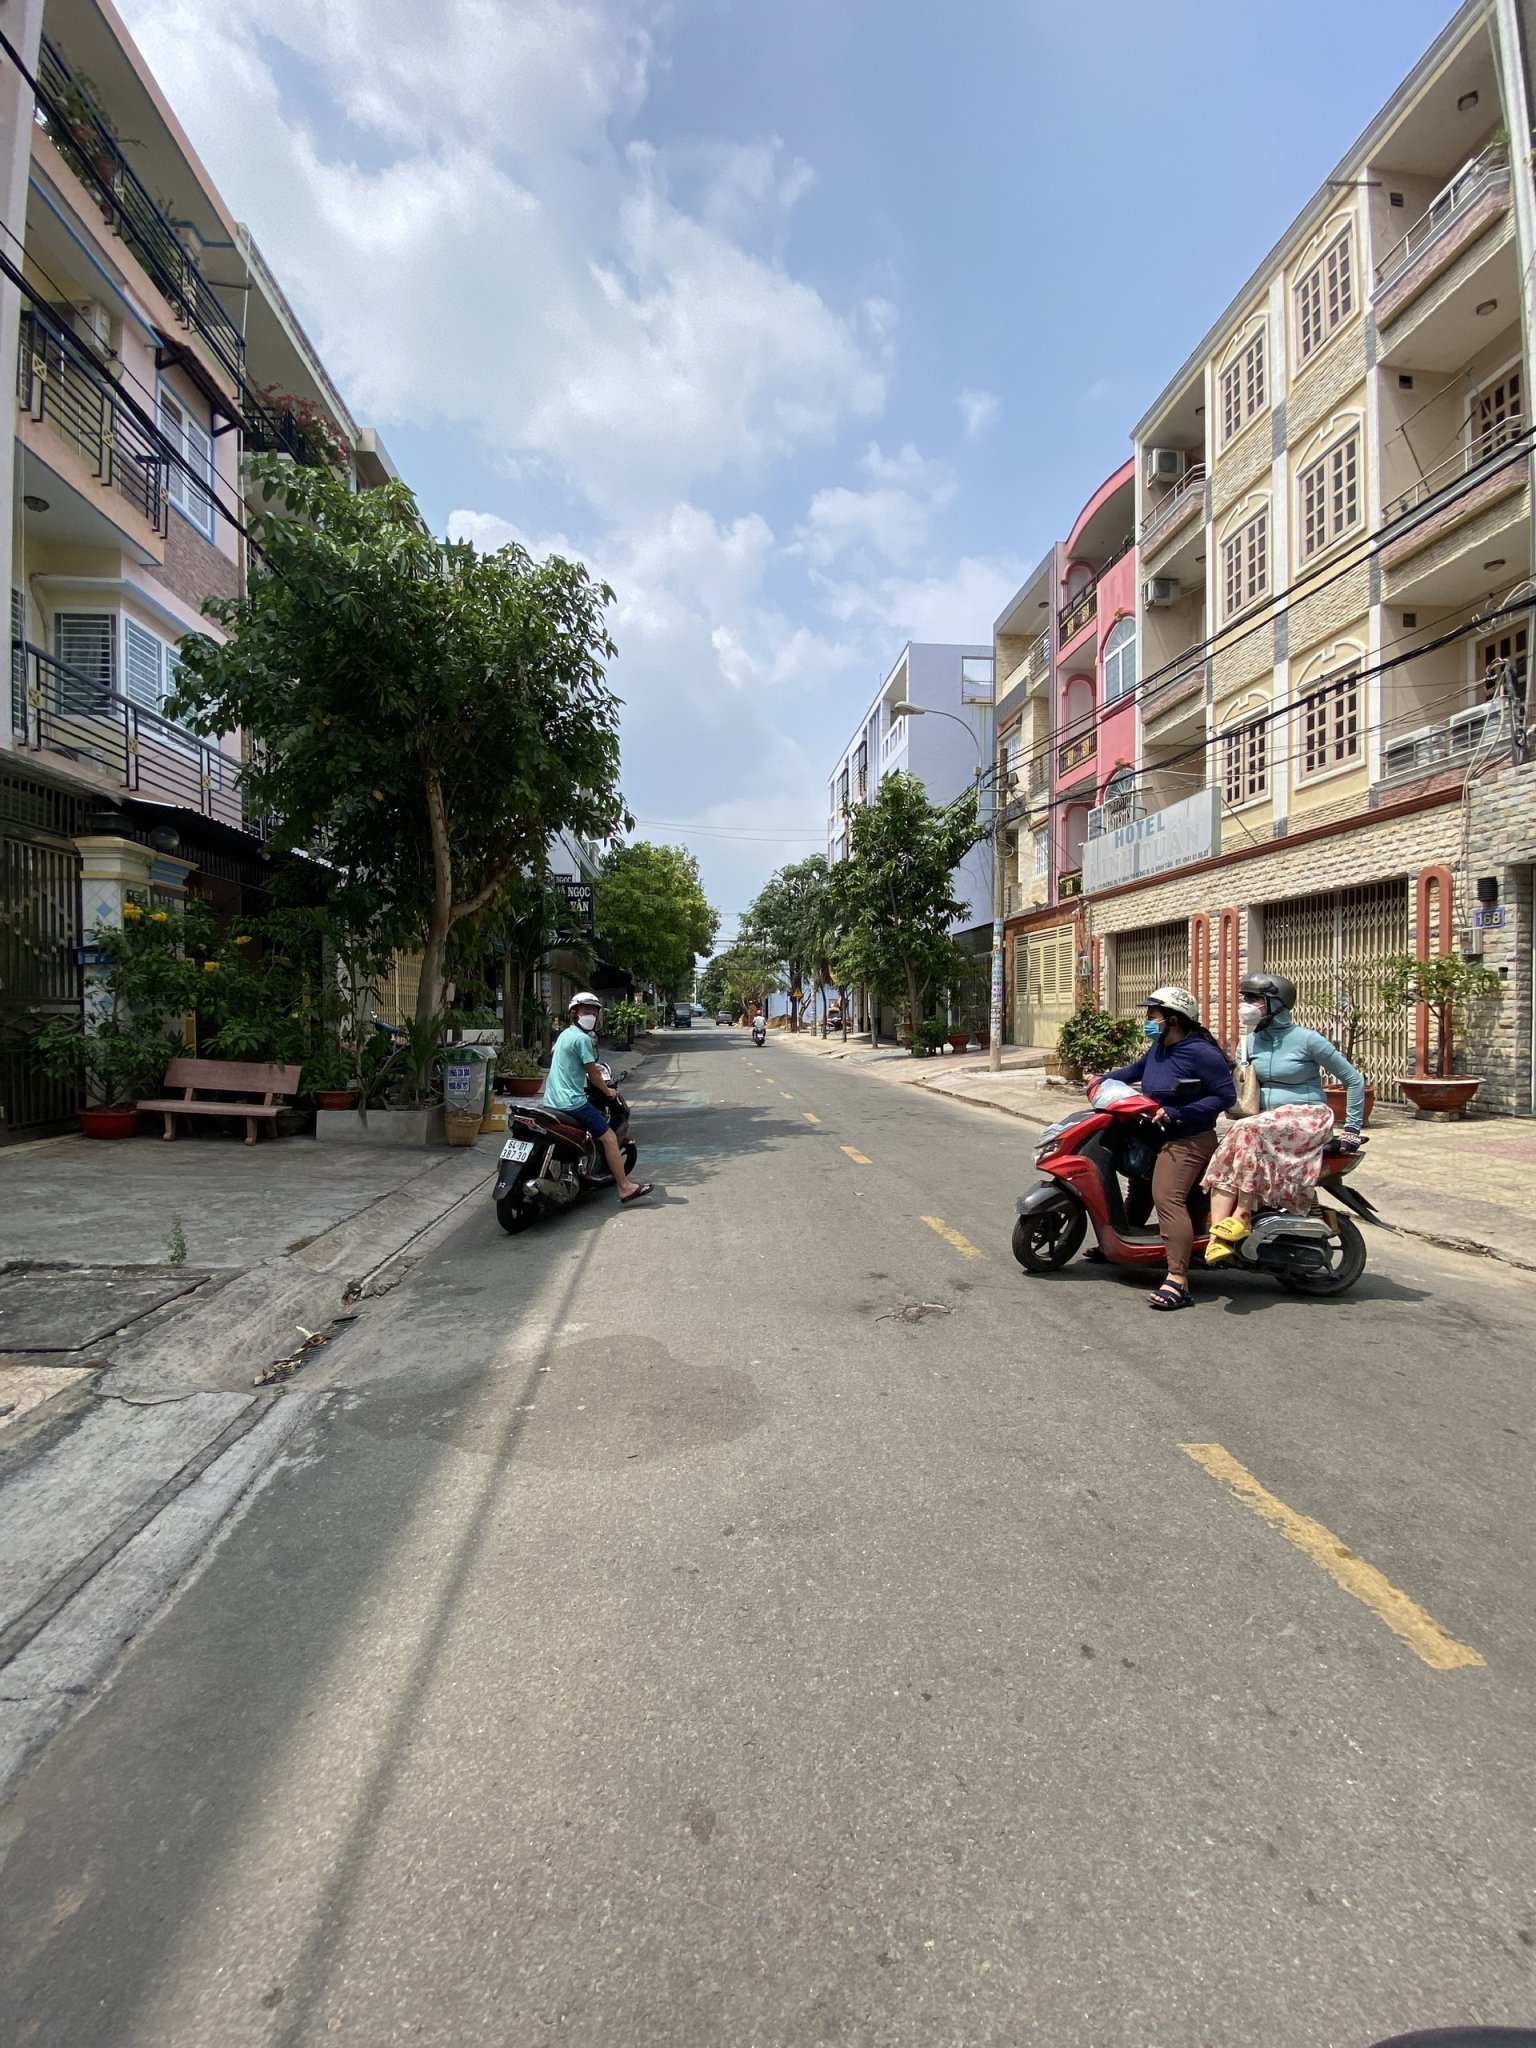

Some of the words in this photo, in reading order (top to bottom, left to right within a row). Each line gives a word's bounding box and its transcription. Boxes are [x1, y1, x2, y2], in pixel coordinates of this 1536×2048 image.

[1115, 813, 1165, 849] HOTEL
[1090, 848, 1133, 883] MINH
[567, 886, 591, 899] NGỌC
[569, 898, 589, 912] VÂN
[1477, 911, 1500, 926] 168
